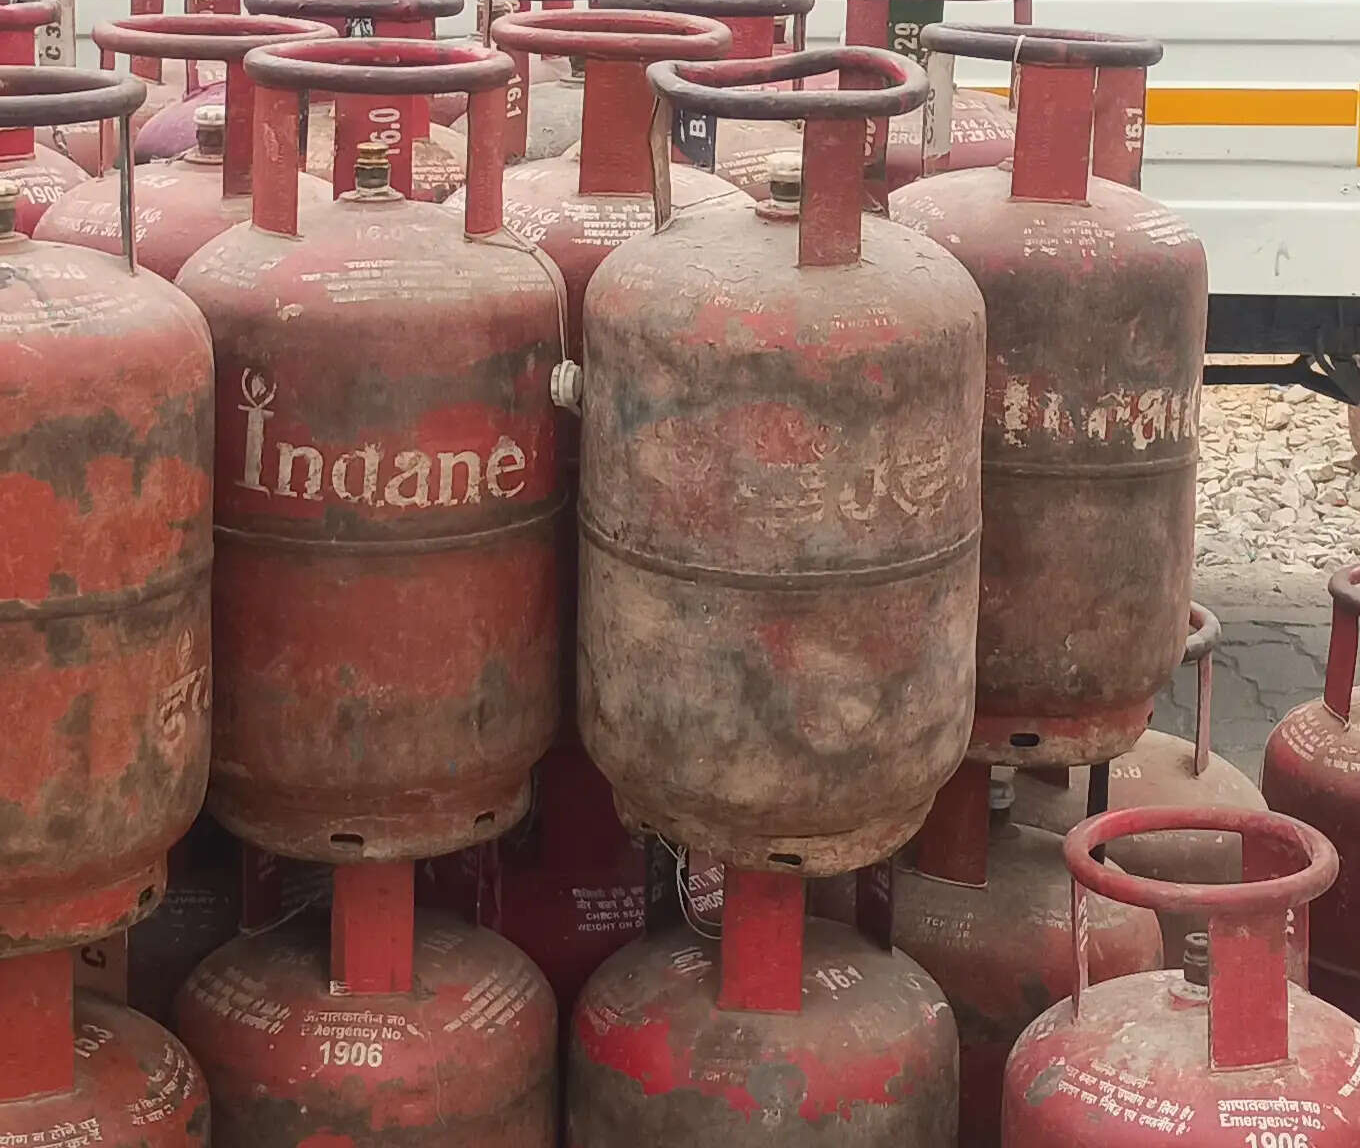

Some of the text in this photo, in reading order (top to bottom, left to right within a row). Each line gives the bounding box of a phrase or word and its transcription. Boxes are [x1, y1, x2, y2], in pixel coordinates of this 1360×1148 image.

[320, 1040, 383, 1068] 1906
[1219, 1113, 1326, 1132] Emergency No.
[1245, 1132, 1309, 1148] 1906
